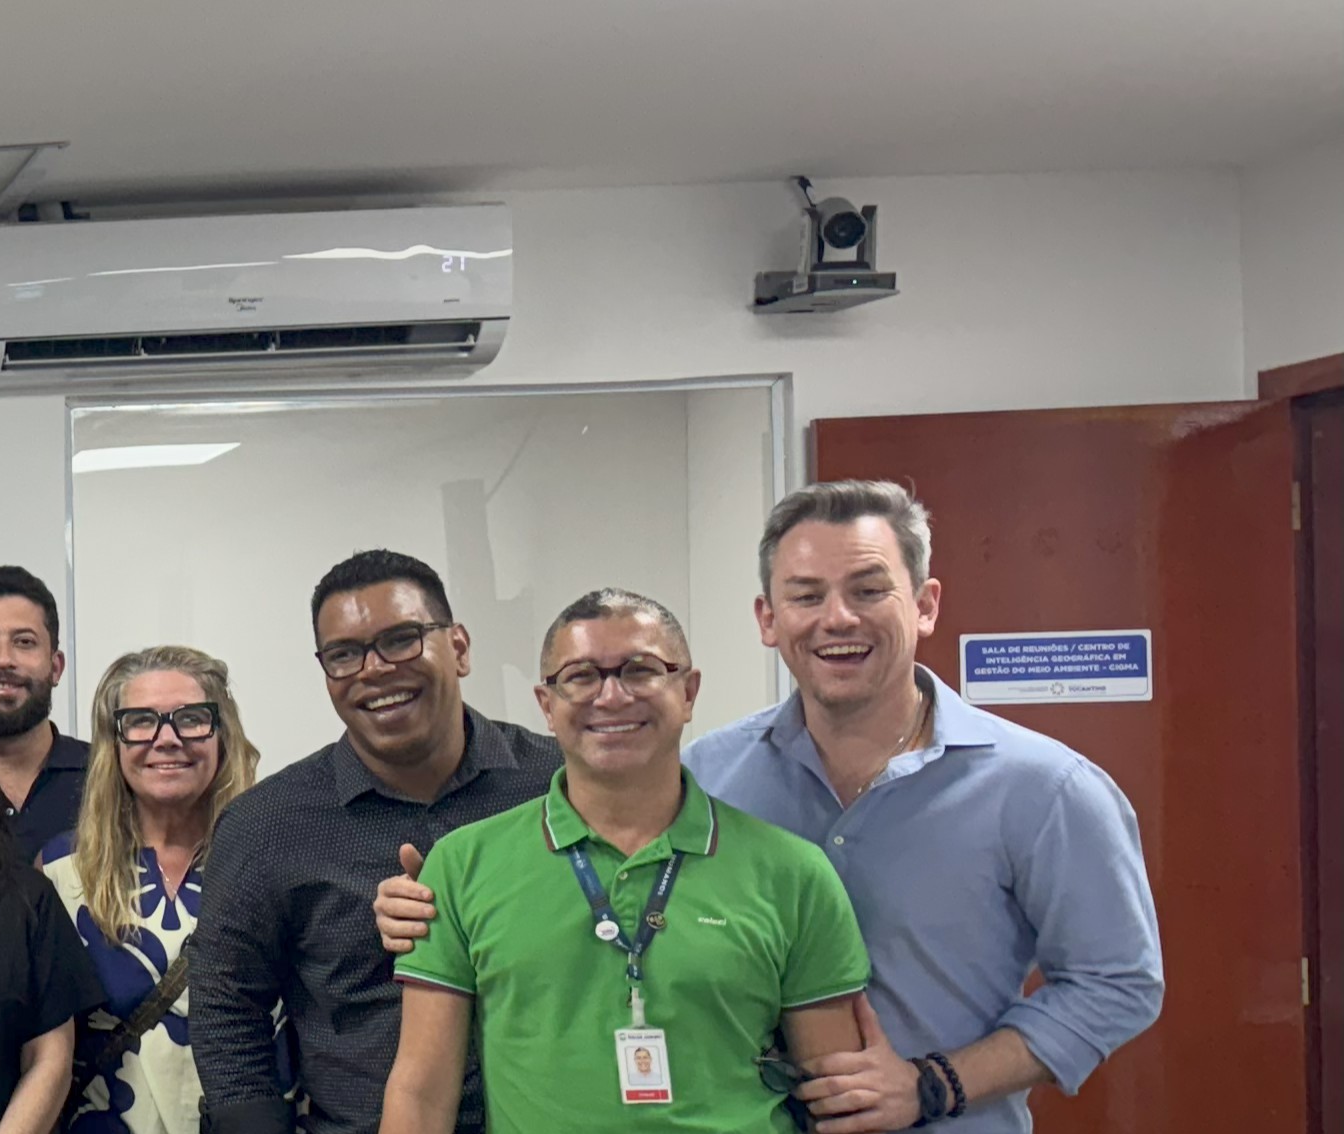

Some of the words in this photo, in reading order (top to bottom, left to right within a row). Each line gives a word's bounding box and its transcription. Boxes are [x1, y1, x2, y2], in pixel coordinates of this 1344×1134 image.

[982, 646, 1006, 654] SALA
[1008, 645, 1021, 653] DE
[1022, 643, 1069, 653] REUNIÕES
[1078, 642, 1115, 651] CENTRO
[1118, 642, 1130, 650] DE
[974, 665, 1010, 675] GESTÃO
[1012, 666, 1026, 674] DO
